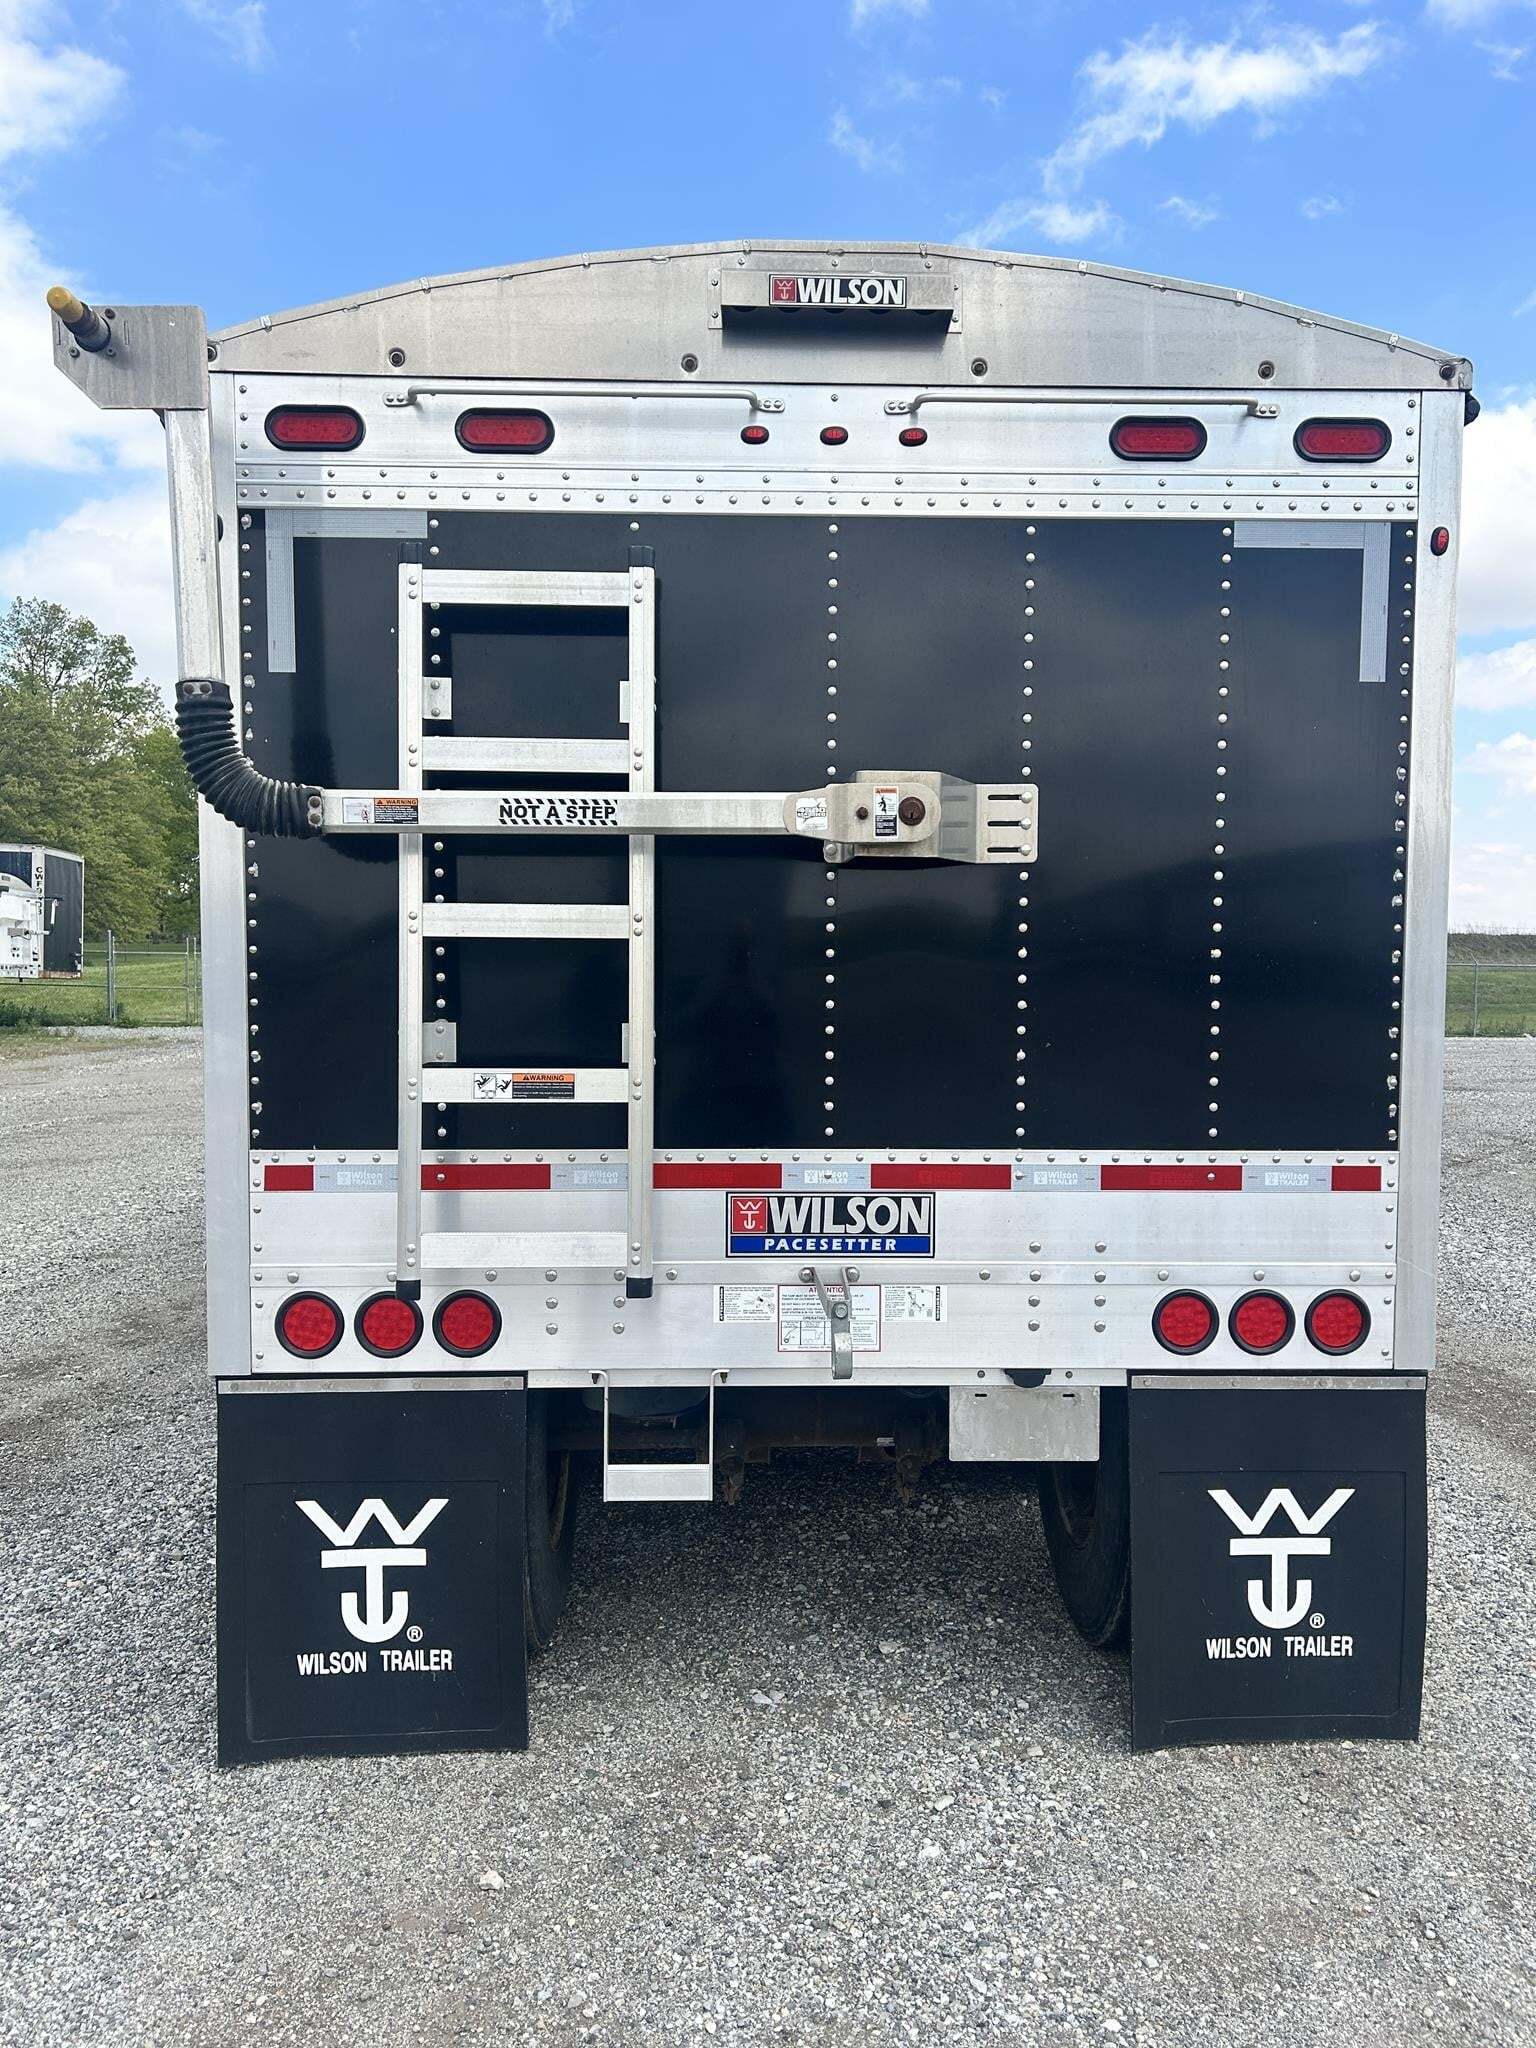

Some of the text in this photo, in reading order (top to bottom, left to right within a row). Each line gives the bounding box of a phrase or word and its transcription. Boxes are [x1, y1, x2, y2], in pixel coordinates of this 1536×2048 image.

[797, 278, 903, 304] WILSON
[499, 805, 616, 819] NOT A STEP
[769, 1197, 930, 1234] WILSON
[764, 1238, 897, 1251] PACESETTER
[1206, 1636, 1354, 1660] WILSON TRAILER
[297, 1649, 453, 1676] WILSON TRAILER
